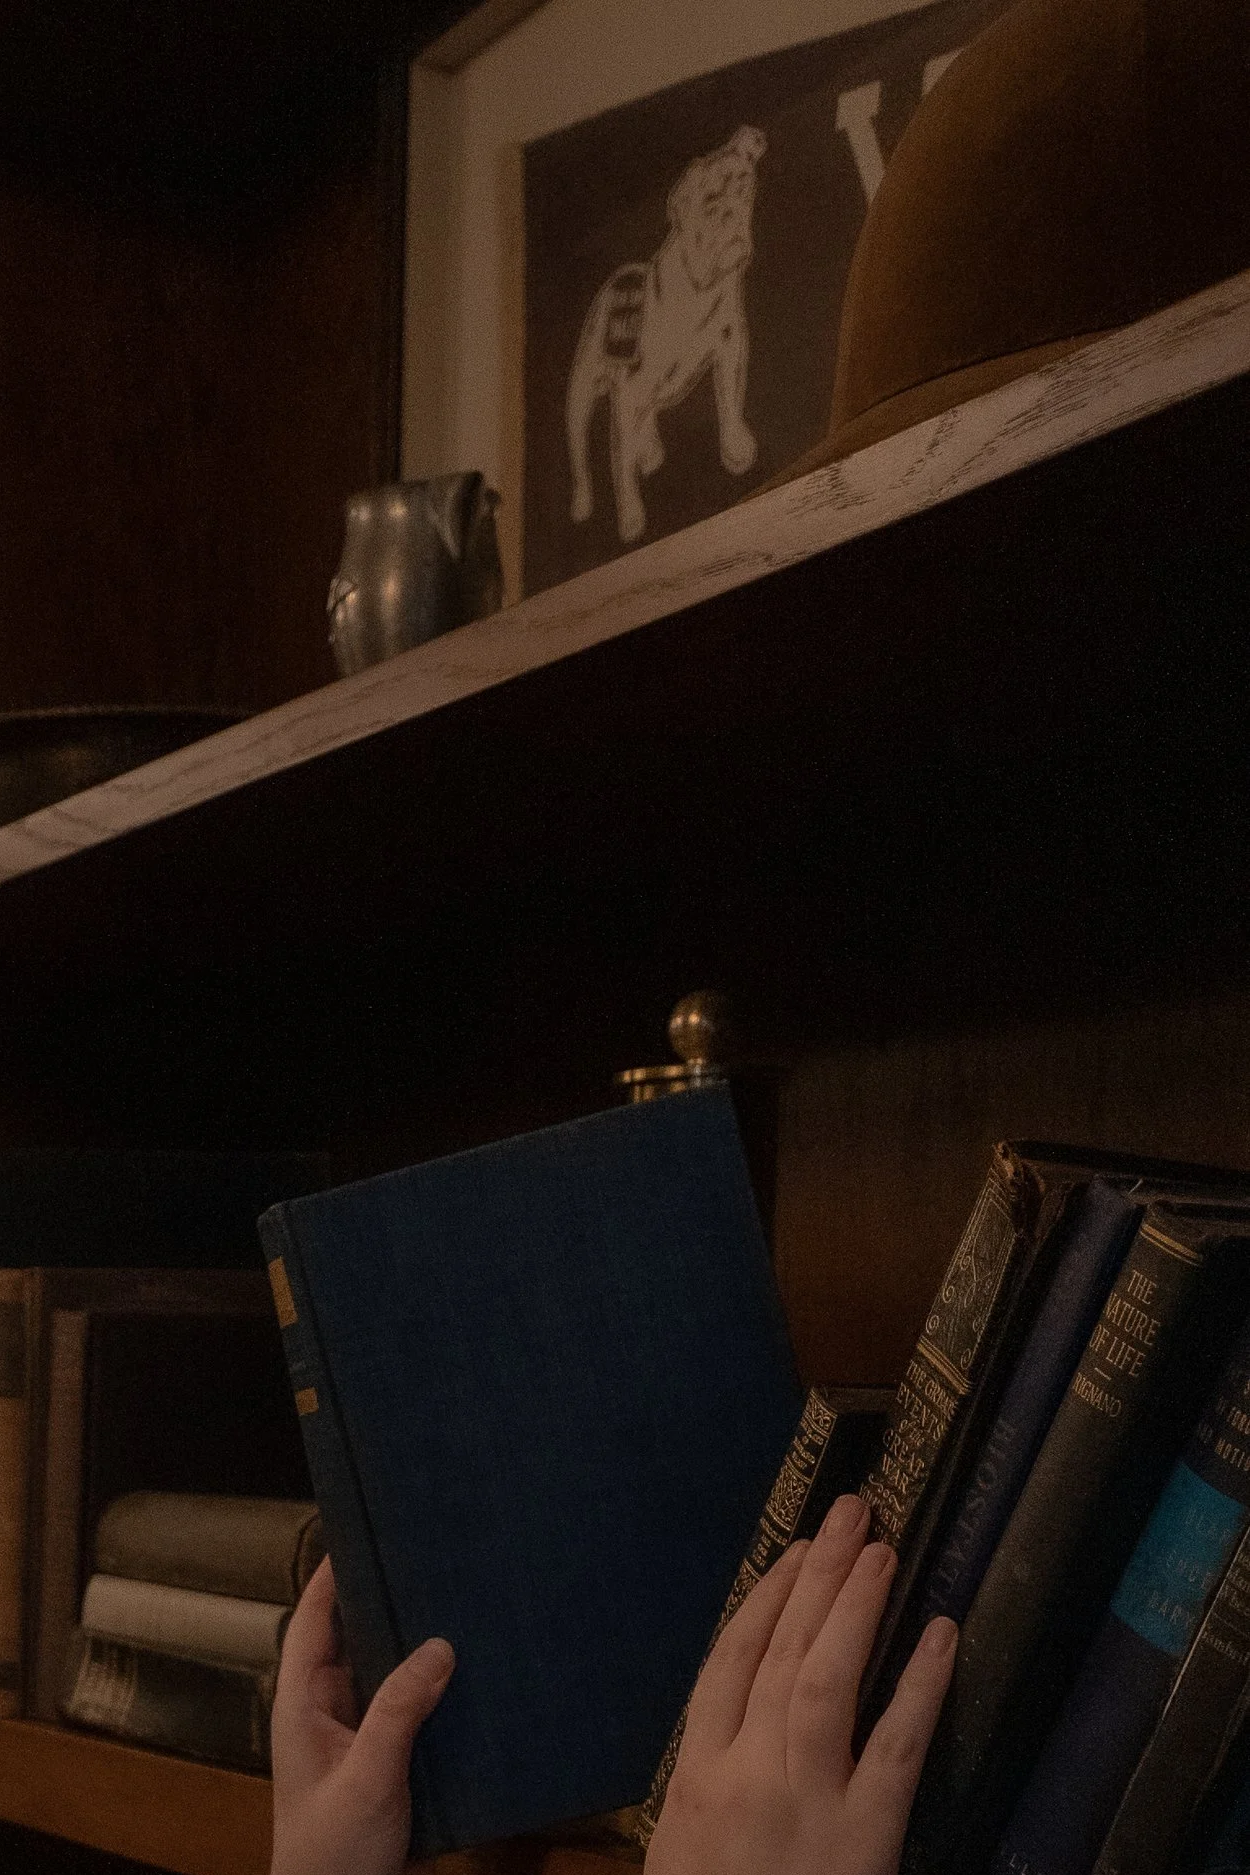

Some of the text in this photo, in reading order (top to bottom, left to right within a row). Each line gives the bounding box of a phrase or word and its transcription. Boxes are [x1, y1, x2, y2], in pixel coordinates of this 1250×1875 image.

[1128, 1269, 1157, 1304] THE
[1106, 1292, 1161, 1346] NATURE
[906, 1359, 928, 1388] THE
[1089, 1324, 1146, 1377] OF LIFE
[897, 1382, 944, 1441] EVENTS
[1073, 1372, 1122, 1418] RIGNANO
[882, 1453, 909, 1494] WAR
[883, 1428, 925, 1479] GREAT
[924, 1417, 1016, 1608] BIOSTATI
